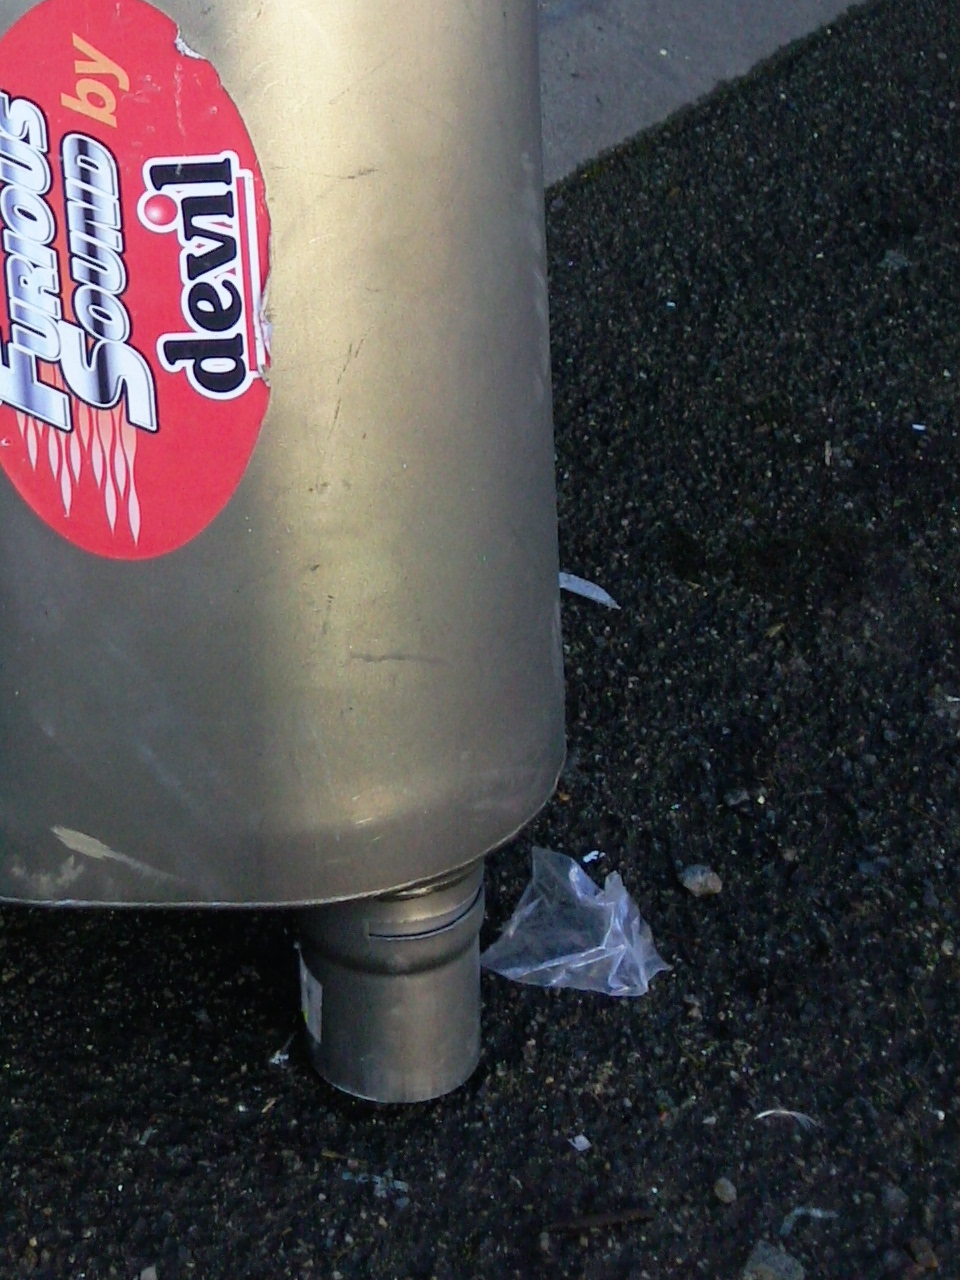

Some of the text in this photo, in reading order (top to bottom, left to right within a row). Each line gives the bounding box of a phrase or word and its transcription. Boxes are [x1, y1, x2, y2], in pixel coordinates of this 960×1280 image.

[59, 33, 159, 432] SOUND by
[139, 154, 252, 400] devil
